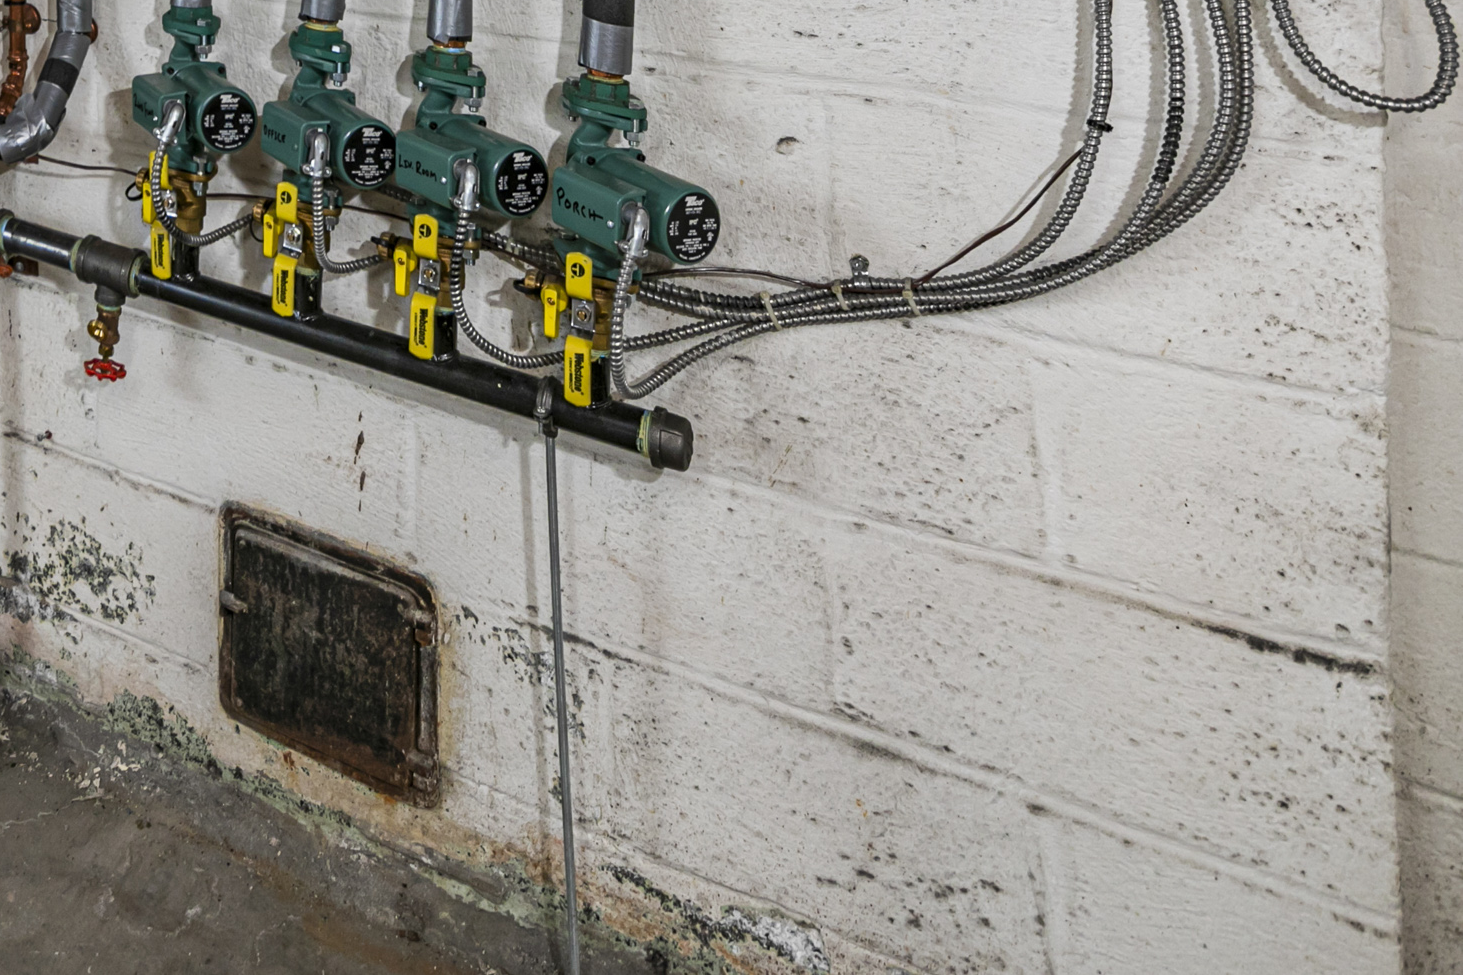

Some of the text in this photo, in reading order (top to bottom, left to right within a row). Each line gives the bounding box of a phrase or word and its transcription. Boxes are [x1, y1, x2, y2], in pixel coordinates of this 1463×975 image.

[263, 124, 287, 144] OFFICE
[556, 186, 604, 222] PORCH
[418, 308, 428, 346] Webstone
[574, 352, 584, 393] Webstone
